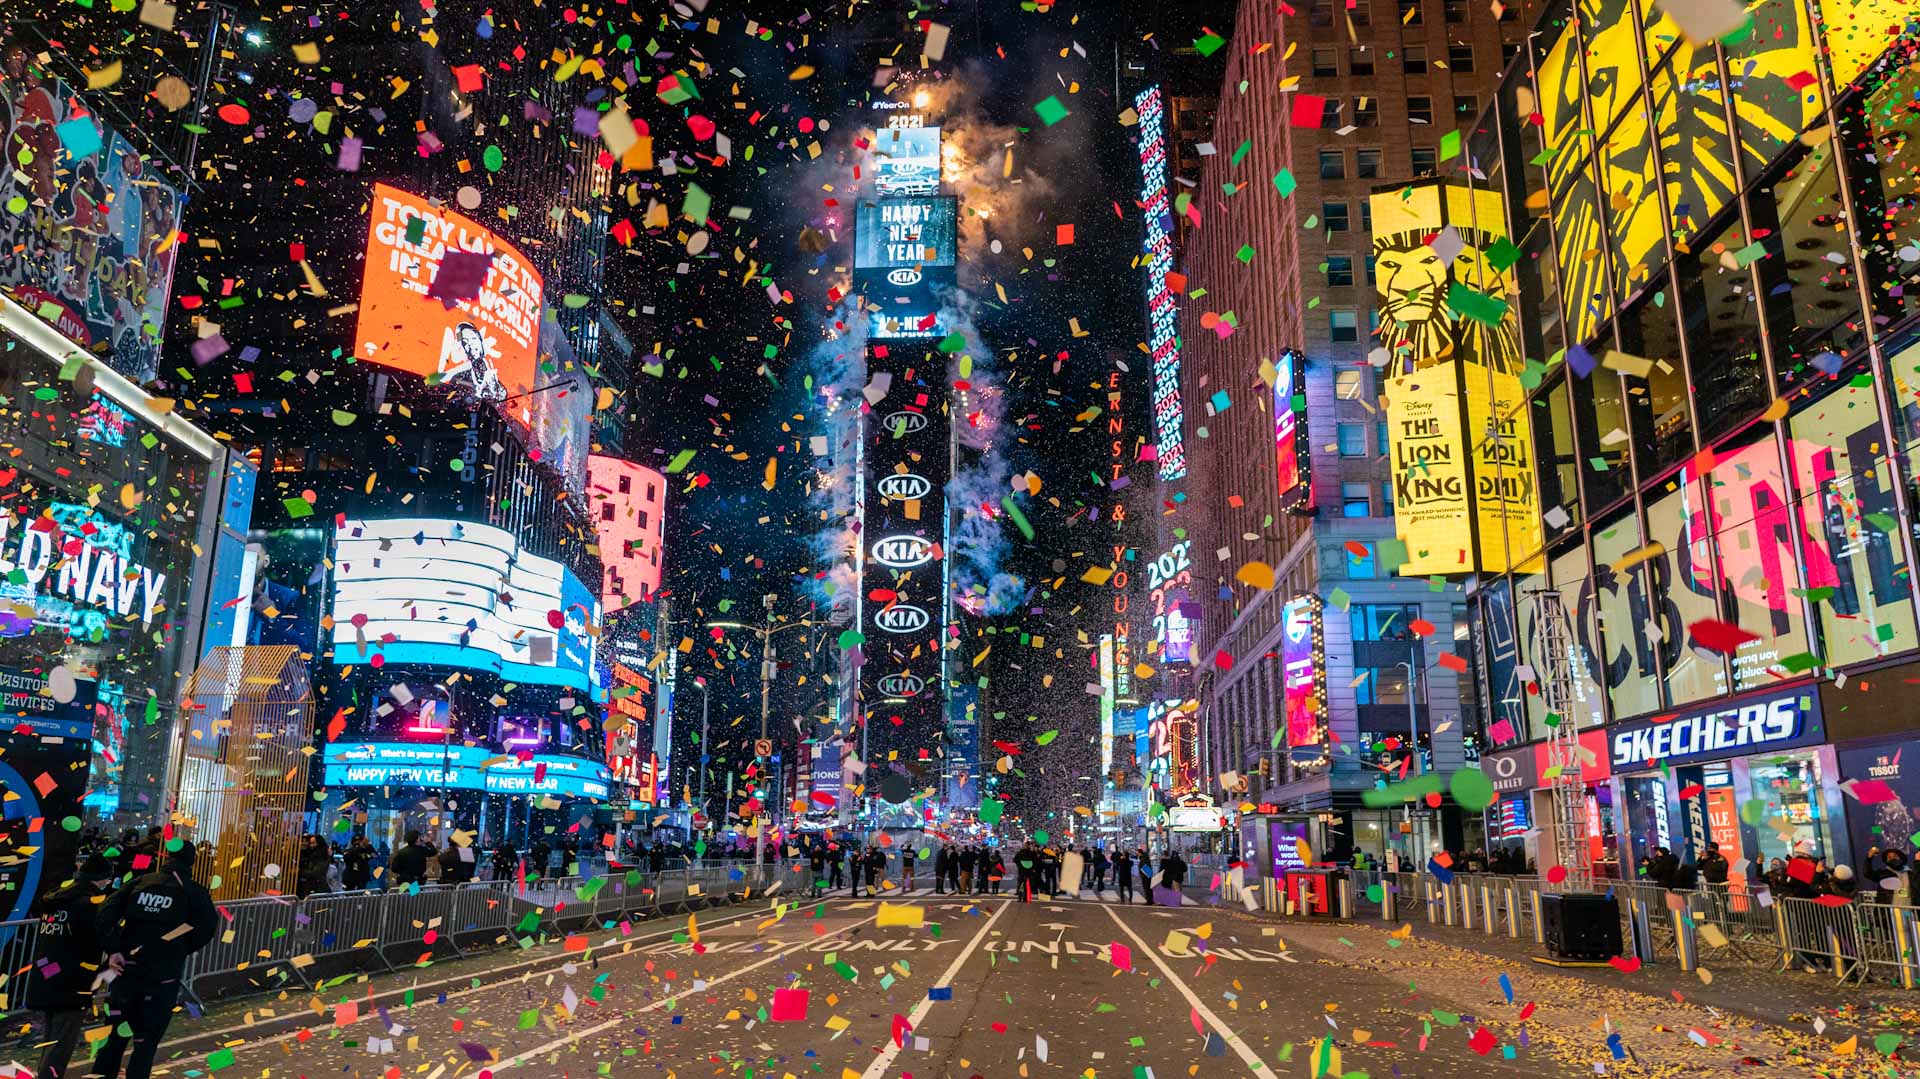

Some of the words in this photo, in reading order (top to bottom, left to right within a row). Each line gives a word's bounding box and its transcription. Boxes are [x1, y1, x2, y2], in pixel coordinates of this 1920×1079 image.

[872, 102, 910, 110] #YearOn
[889, 115, 924, 129] 2021
[1138, 126, 1163, 154] 2021
[1140, 137, 1165, 165] 2021
[1142, 174, 1166, 202] 2021
[383, 197, 455, 241] TORY
[882, 205, 931, 222] HAPPY
[890, 225, 922, 241] NEW
[887, 244, 925, 261] YEAR
[390, 250, 421, 278] IN
[893, 271, 916, 282] KIA
[57, 318, 84, 339] AVY
[1150, 325, 1175, 353] 2021
[1152, 336, 1177, 362] 2021
[1153, 376, 1179, 404] 2021
[1155, 389, 1180, 416] 2021
[1109, 372, 1123, 480] ERNST
[1401, 417, 1439, 436] THE
[1157, 430, 1182, 457] 2021
[1159, 442, 1184, 469] 2021
[1397, 441, 1451, 469] LION
[887, 479, 921, 494] KIA
[1395, 472, 1462, 509] KING
[1112, 504, 1126, 521] &
[883, 542, 923, 560] KIA
[58, 534, 166, 625] NAVY
[1112, 546, 1129, 666] YOUNG
[884, 611, 920, 627] KIA
[885, 678, 916, 692] KIA
[3, 692, 56, 712] ERVICES
[1613, 696, 1795, 766] SKECHERS
[348, 768, 387, 781] HAPPY
[425, 769, 459, 783] YEAR
[1868, 765, 1900, 777] TISSOT
[499, 777, 527, 790] NEW
[1652, 780, 1672, 854] SKECH
[1278, 844, 1299, 853] Wher
[137, 892, 173, 909] NYPD
[144, 905, 160, 913] DCPI
[40, 922, 64, 936] DCPI
[808, 938, 960, 952] ONLY
